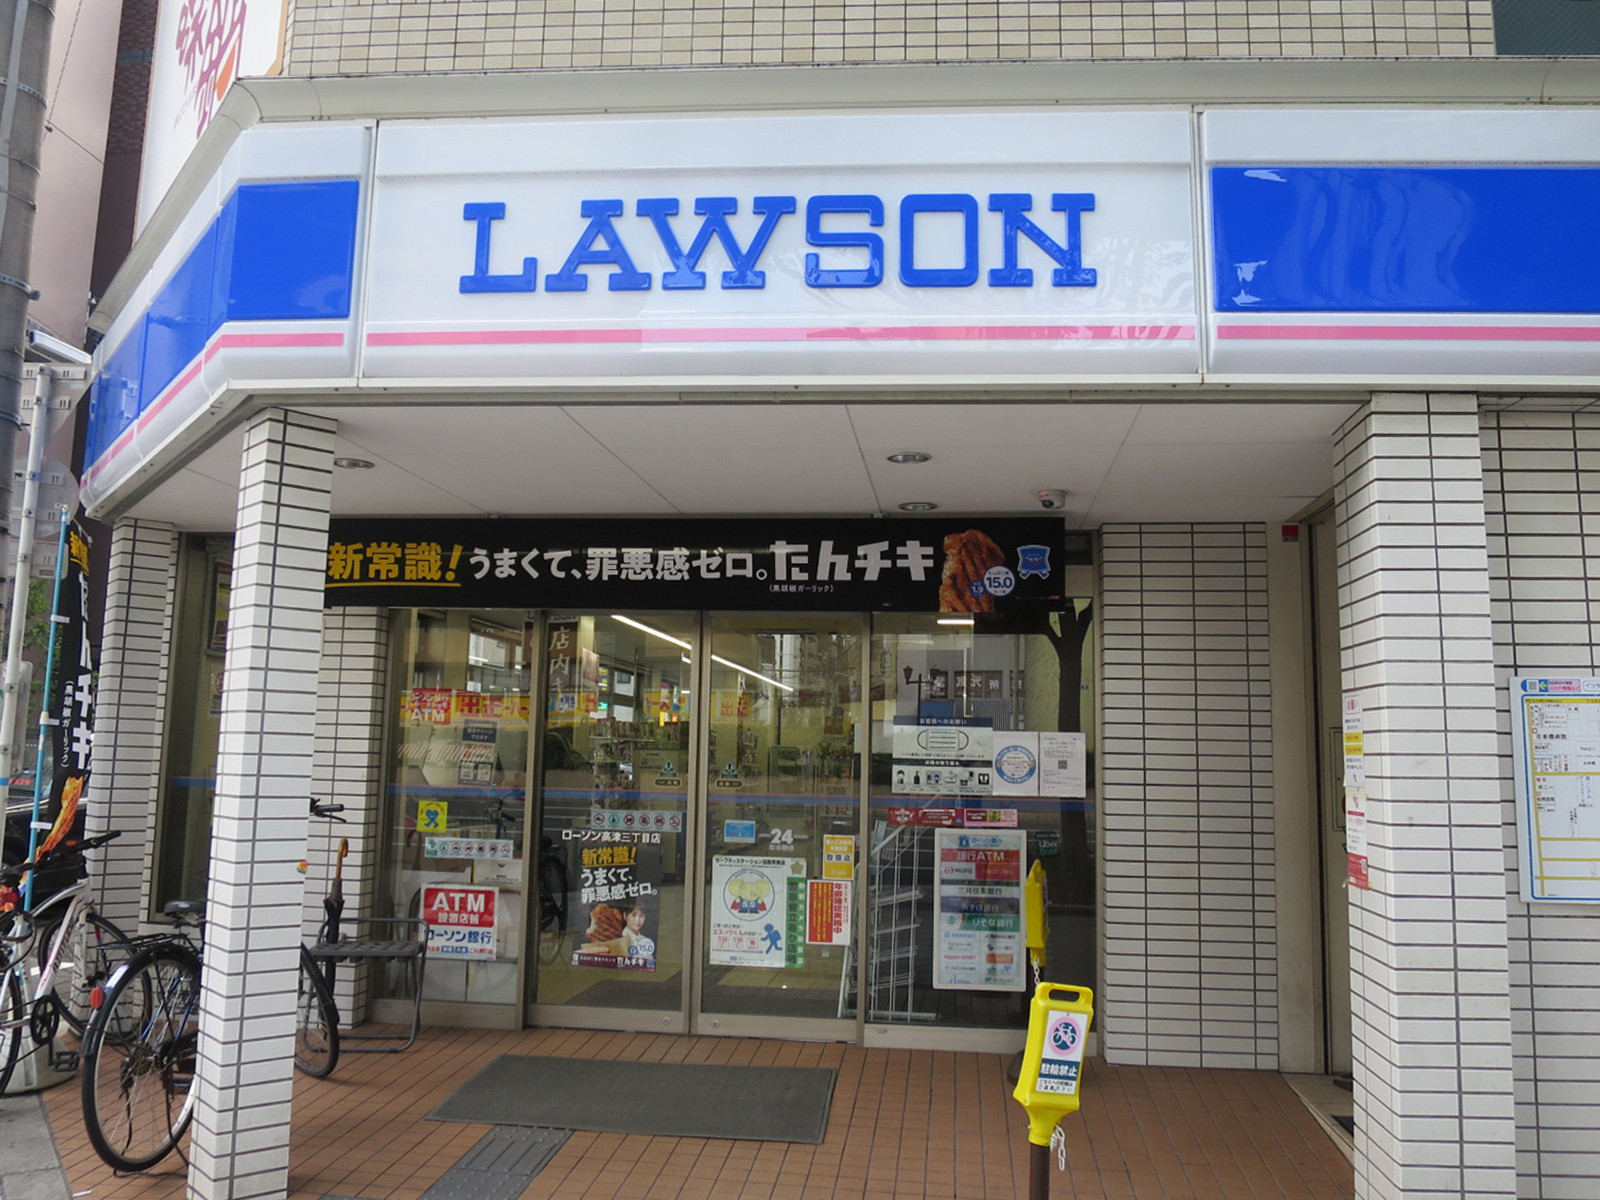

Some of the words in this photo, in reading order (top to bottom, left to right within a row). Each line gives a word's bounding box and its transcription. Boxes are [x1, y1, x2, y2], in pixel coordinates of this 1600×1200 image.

[460, 193, 1097, 293] LAWSON
[328, 541, 463, 581] 新常識!
[469, 547, 767, 581] うまくて、罪悪感ゼロ。
[769, 539, 934, 582] たんチキ
[985, 576, 1013, 589] 15.0
[562, 830, 662, 844] ローソン高津三丁目店
[770, 828, 794, 845] 24
[1038, 840, 1058, 848] Uber
[581, 846, 637, 866] 新常識!
[957, 851, 1005, 862] 銀行ATM
[580, 883, 659, 905] 罪悪感ゼロ。
[432, 892, 486, 913] ATM
[438, 912, 480, 925] 設置店舗
[972, 919, 1014, 927] りそな銀行
[425, 929, 493, 944] ローソン銀行
[1040, 1063, 1077, 1077] 駐輪禁止
